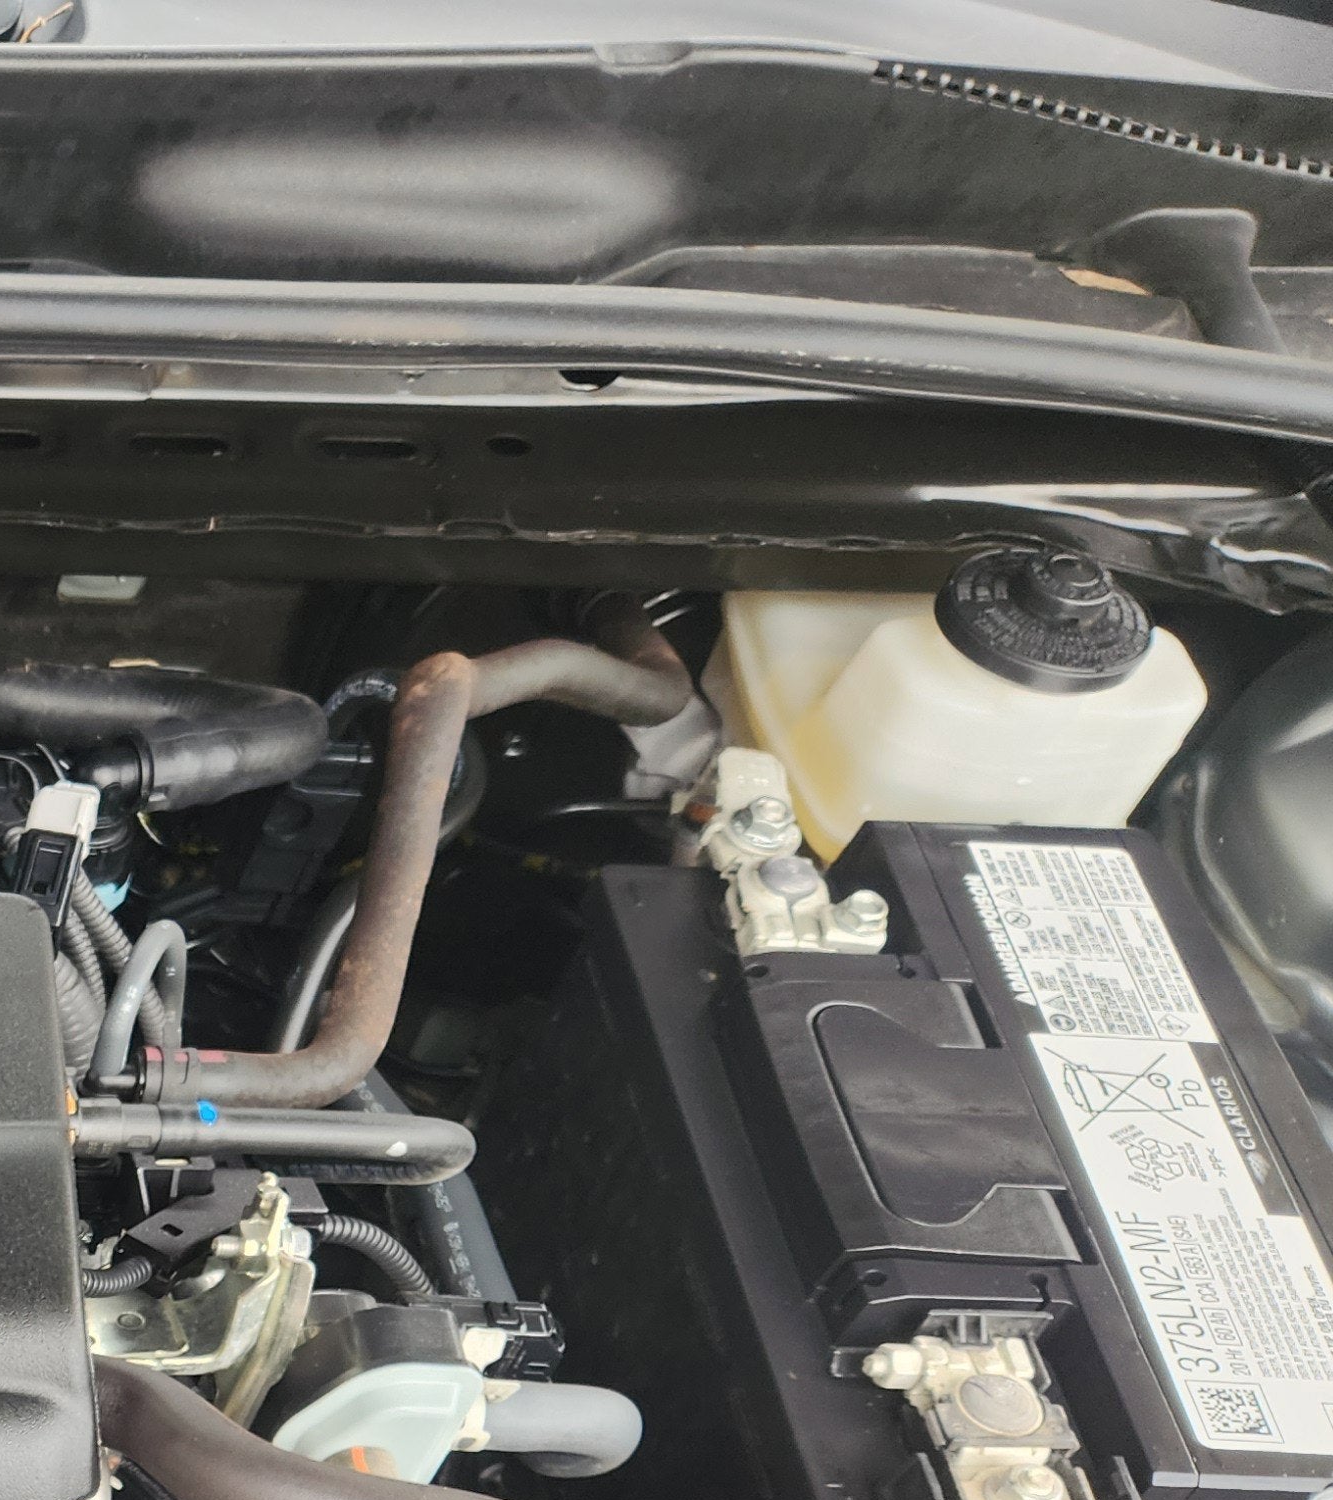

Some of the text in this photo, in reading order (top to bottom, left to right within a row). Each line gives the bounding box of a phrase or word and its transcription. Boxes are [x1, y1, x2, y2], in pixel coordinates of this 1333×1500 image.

[1178, 1079, 1210, 1108] Pb
[1210, 1076, 1256, 1152] CLARIOS
[1115, 1211, 1220, 1374] 375LN2-MF
[1197, 1282, 1219, 1303] CCA
[1214, 1328, 1236, 1342] 60
